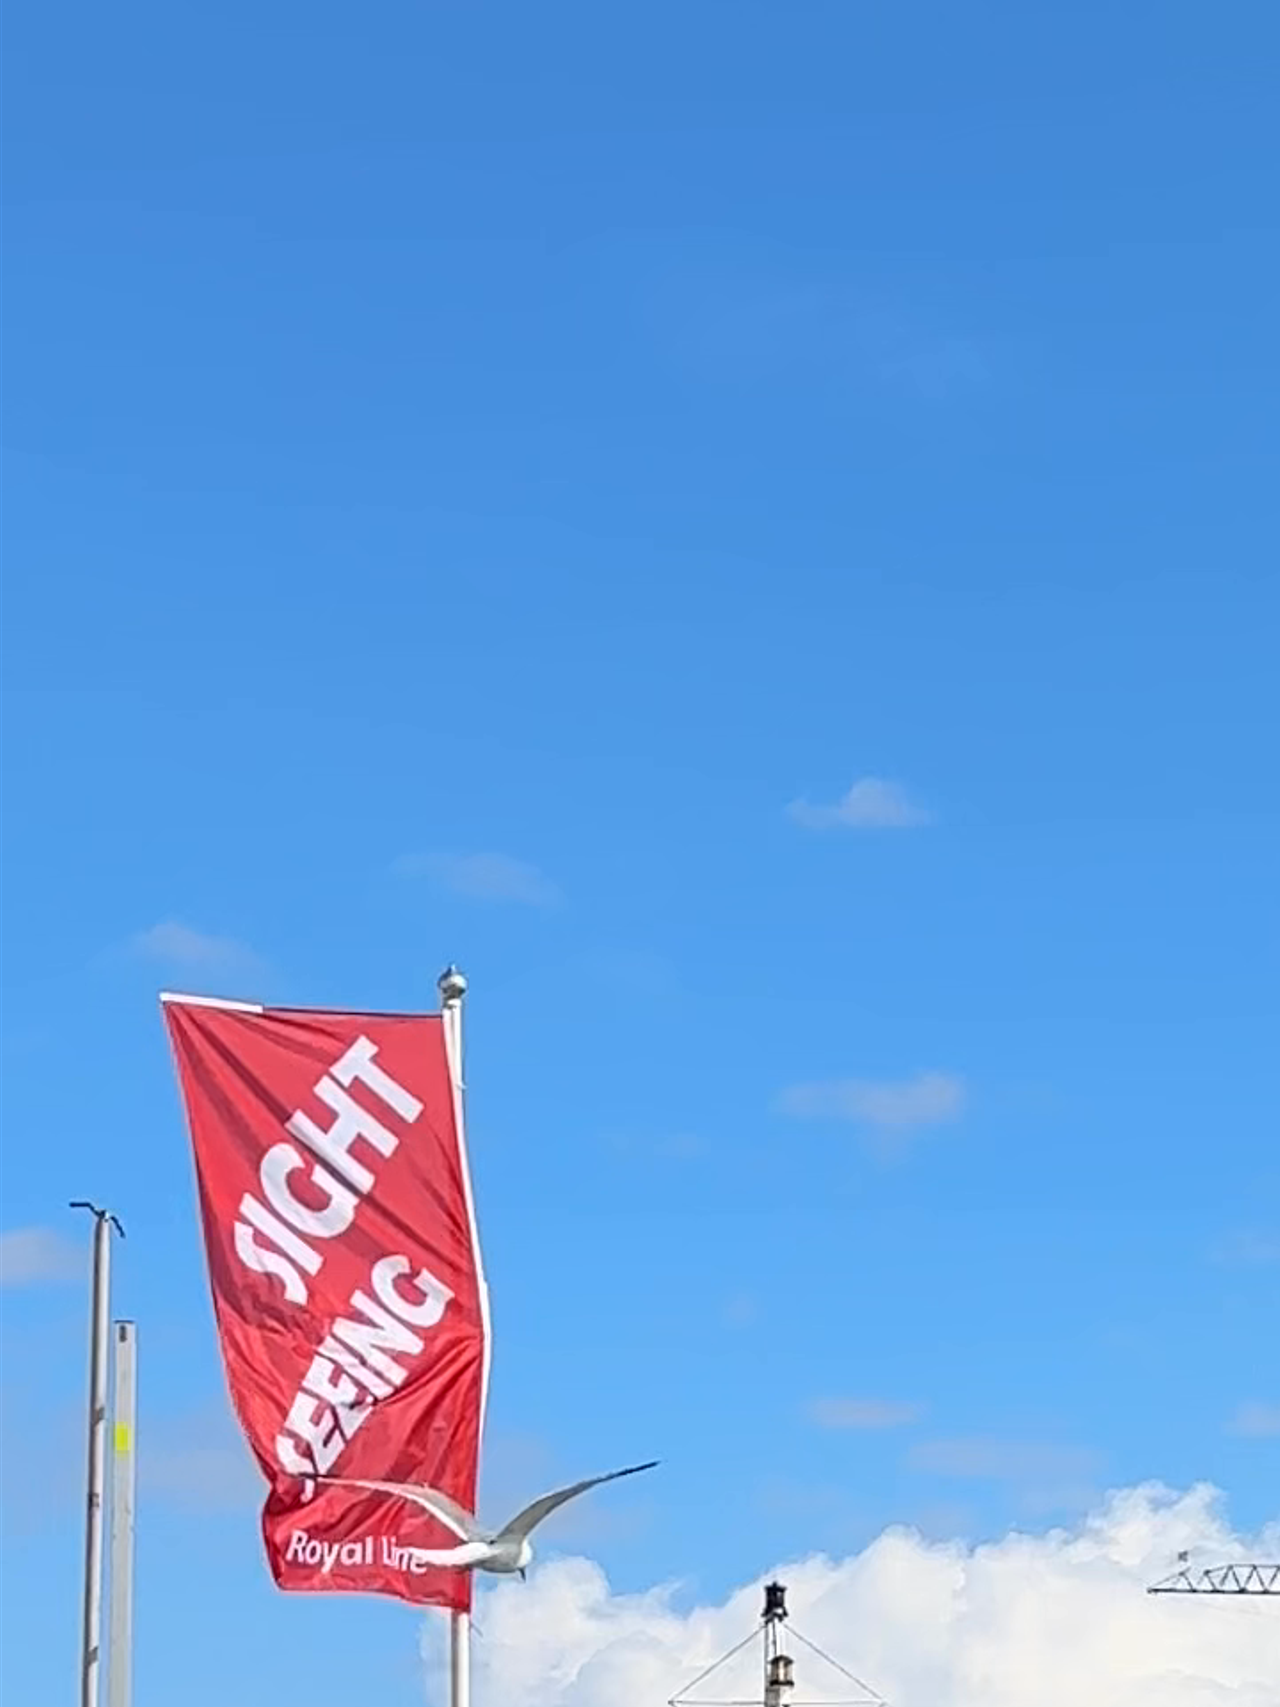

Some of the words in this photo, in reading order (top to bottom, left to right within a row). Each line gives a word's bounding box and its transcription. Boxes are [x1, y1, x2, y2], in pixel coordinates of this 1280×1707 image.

[234, 1034, 424, 1306] SIGHT
[275, 1254, 455, 1503] SEEING
[286, 1530, 374, 1574] Royal
